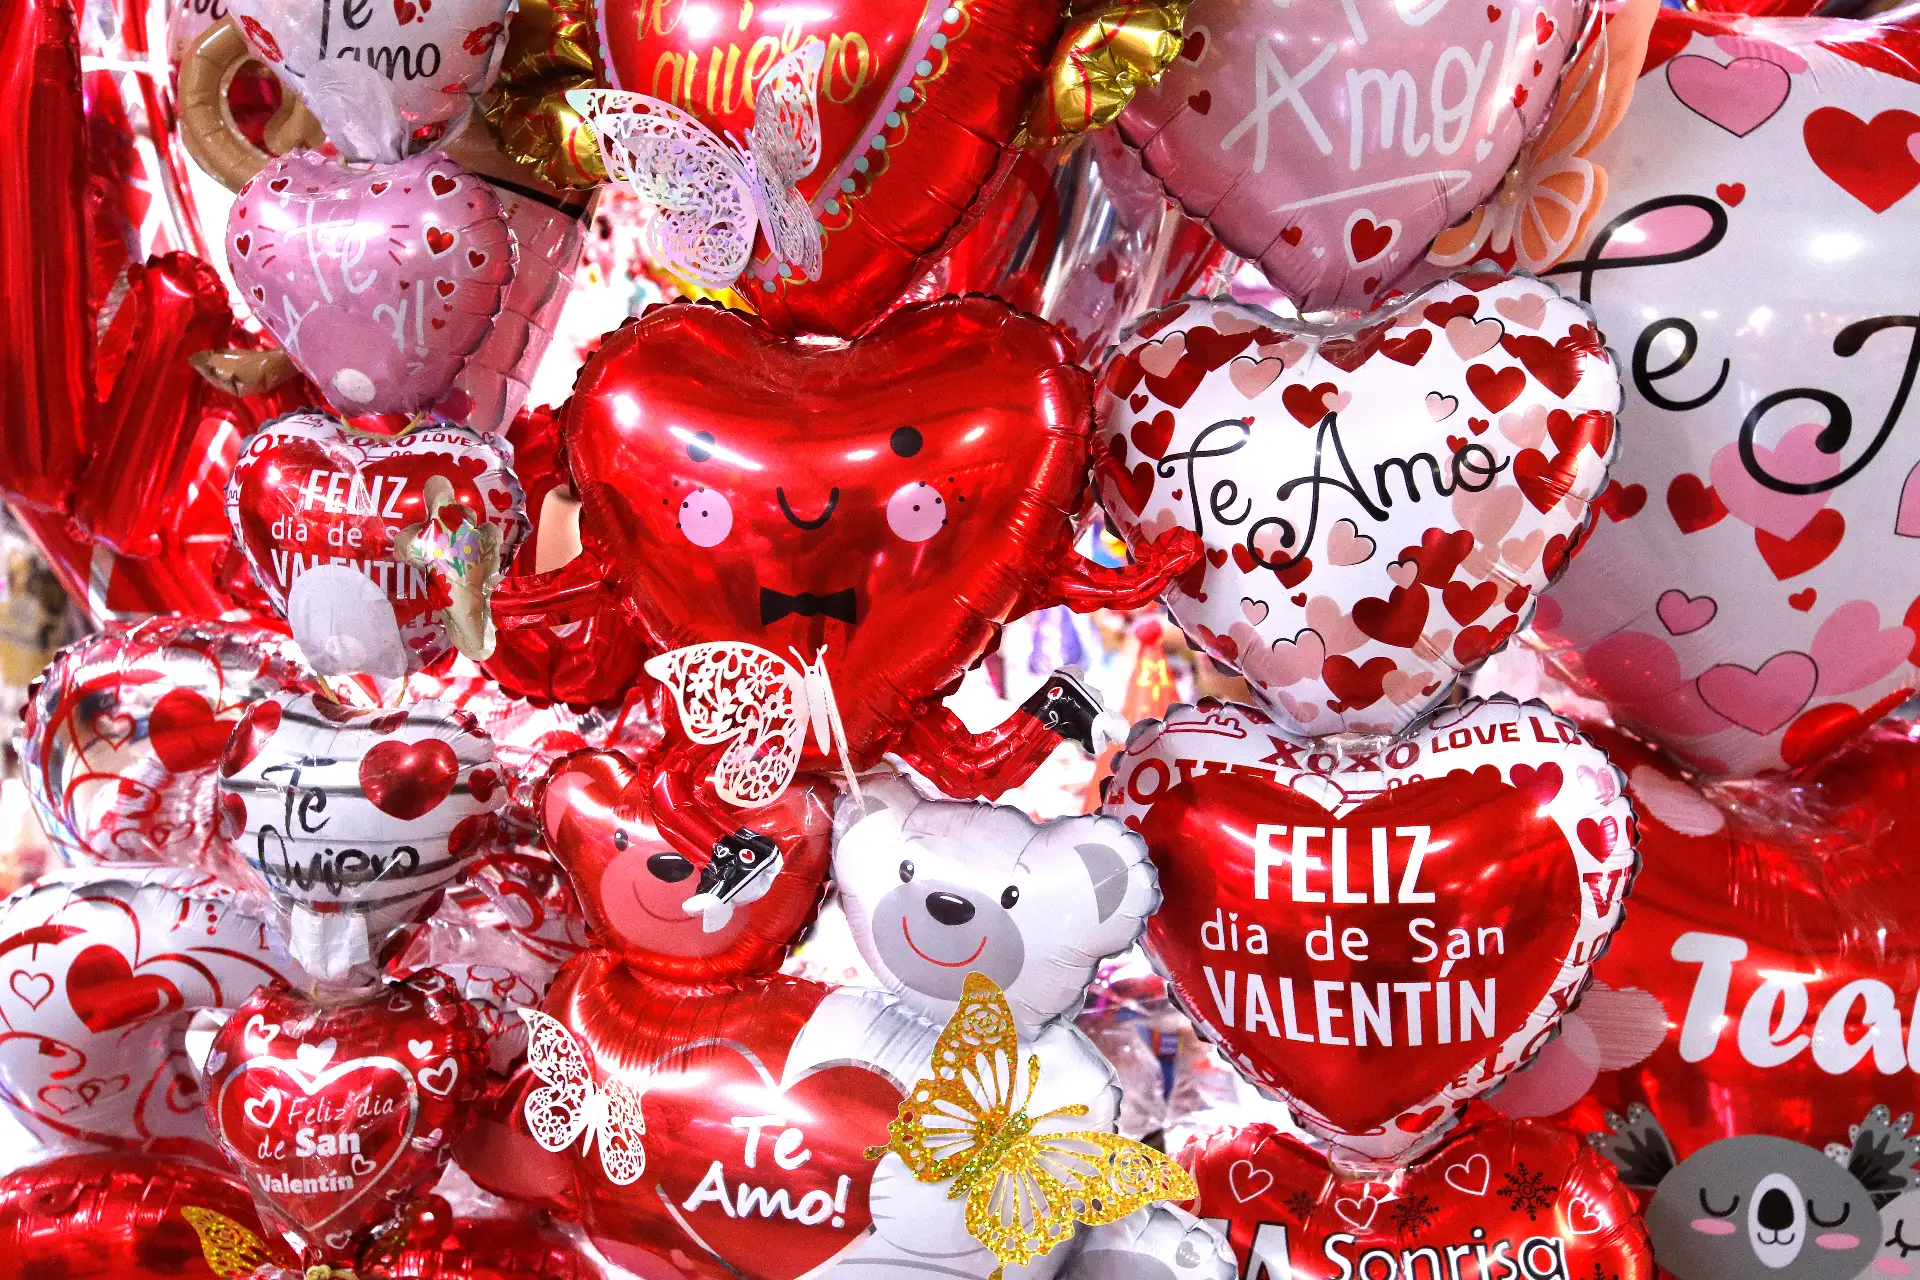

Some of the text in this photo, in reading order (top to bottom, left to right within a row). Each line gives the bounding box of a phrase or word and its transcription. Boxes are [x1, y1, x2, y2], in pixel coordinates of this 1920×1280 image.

[1221, 6, 1520, 173] Amo!
[282, 200, 378, 304] Te
[303, 469, 409, 519] FELIZ
[1157, 411, 1511, 571] Te Amo
[327, 520, 363, 548] de
[1431, 722, 1521, 753] LOVE
[261, 758, 338, 843] Te
[257, 824, 420, 897] Quiero
[1253, 822, 1436, 904] FELIZ
[1306, 918, 1369, 962] de
[1408, 917, 1505, 964] San
[1203, 959, 1496, 1048] VALENTÍN
[1670, 931, 1920, 1076] Tea
[257, 1127, 361, 1161] de San
[287, 1096, 348, 1125] Feliz
[730, 1113, 812, 1171] Te
[256, 1170, 355, 1195] Valentín
[682, 1160, 851, 1229] Amo!
